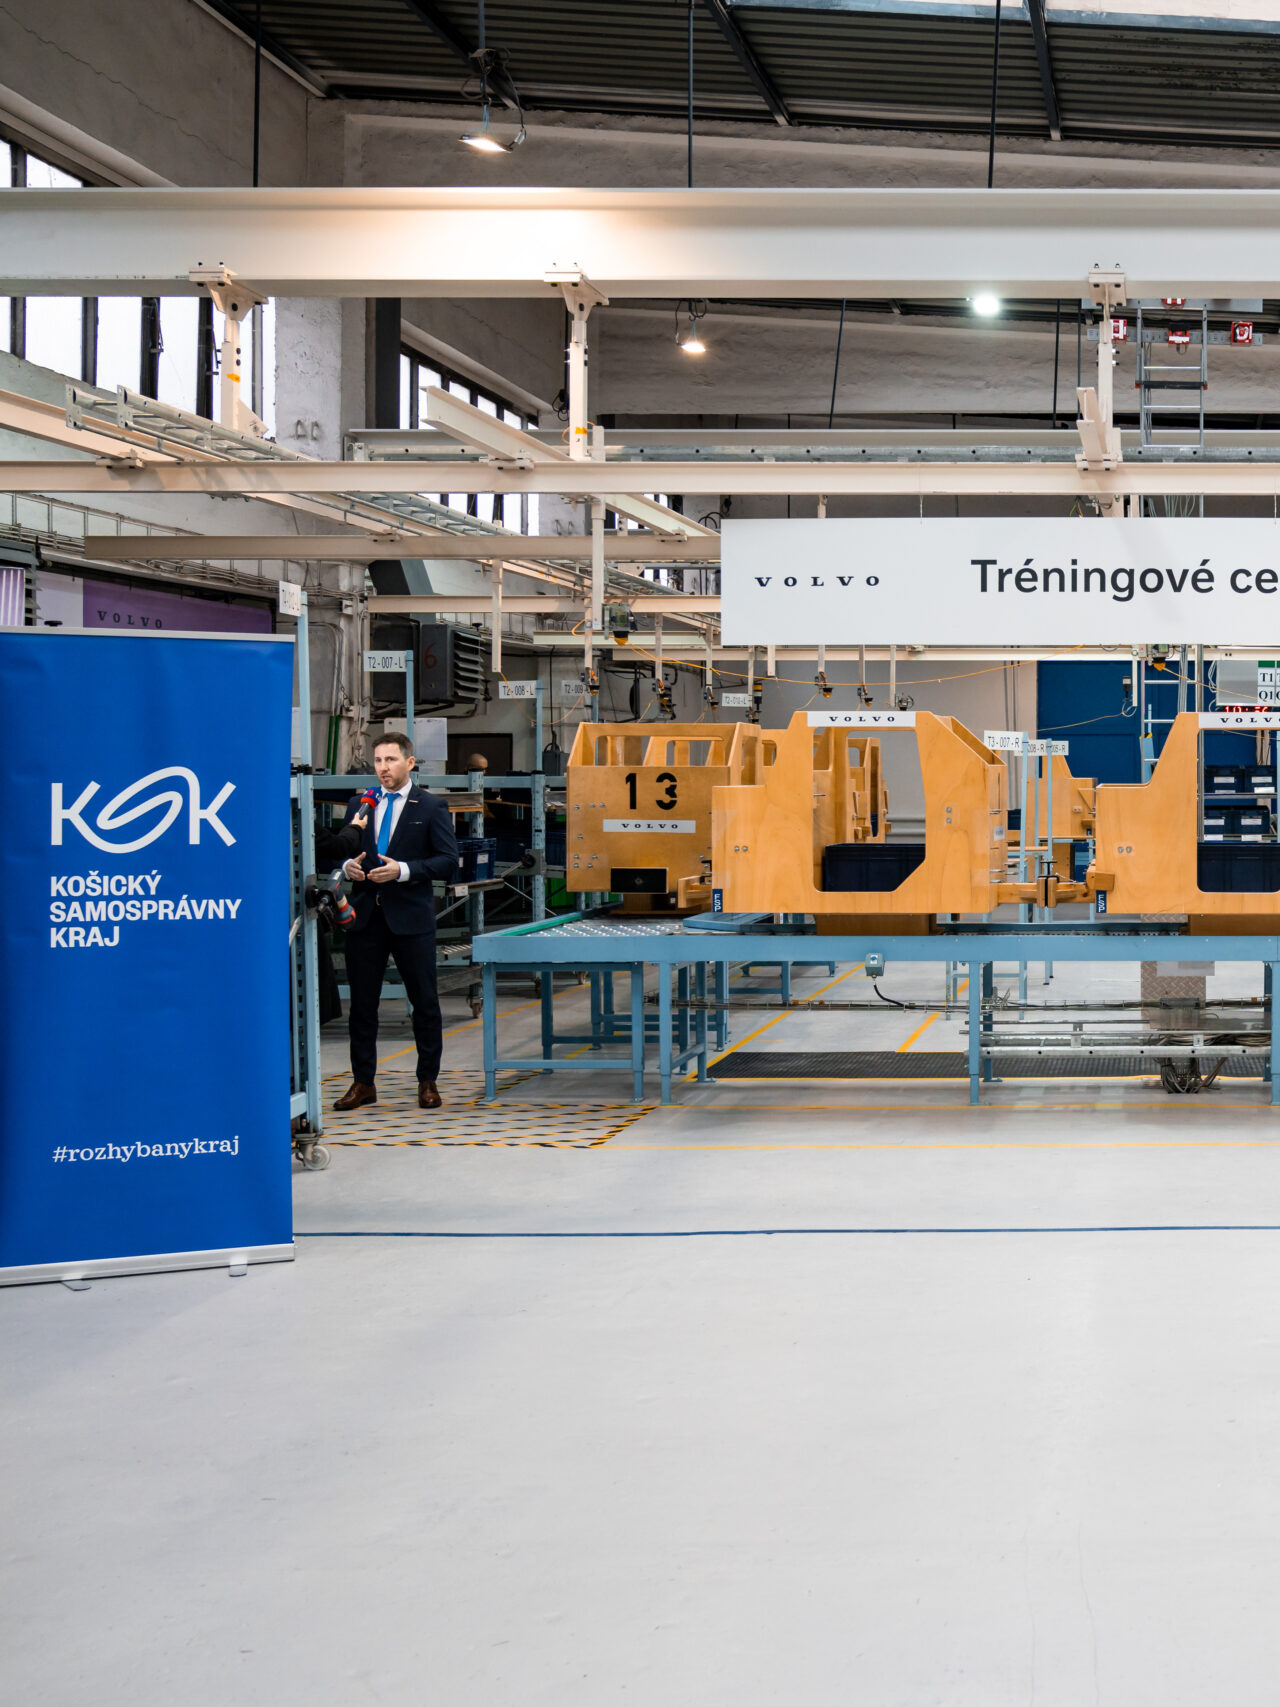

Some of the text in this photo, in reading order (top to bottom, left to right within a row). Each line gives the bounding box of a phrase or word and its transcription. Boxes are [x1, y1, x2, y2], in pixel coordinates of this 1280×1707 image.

[755, 575, 880, 587] VOLVO
[970, 558, 1215, 602] Tréningové
[97, 610, 163, 629] VOLVO
[424, 643, 437, 669] 6
[1259, 673, 1273, 682] T1
[1258, 690, 1273, 702] Q1
[50, 870, 162, 897] KOŠICKÝ
[49, 894, 243, 923] SAMOSPRÁVNY
[714, 893, 722, 912] FSP
[50, 925, 120, 948] KRAJ
[52, 1135, 239, 1163] #rozhybanykraj
